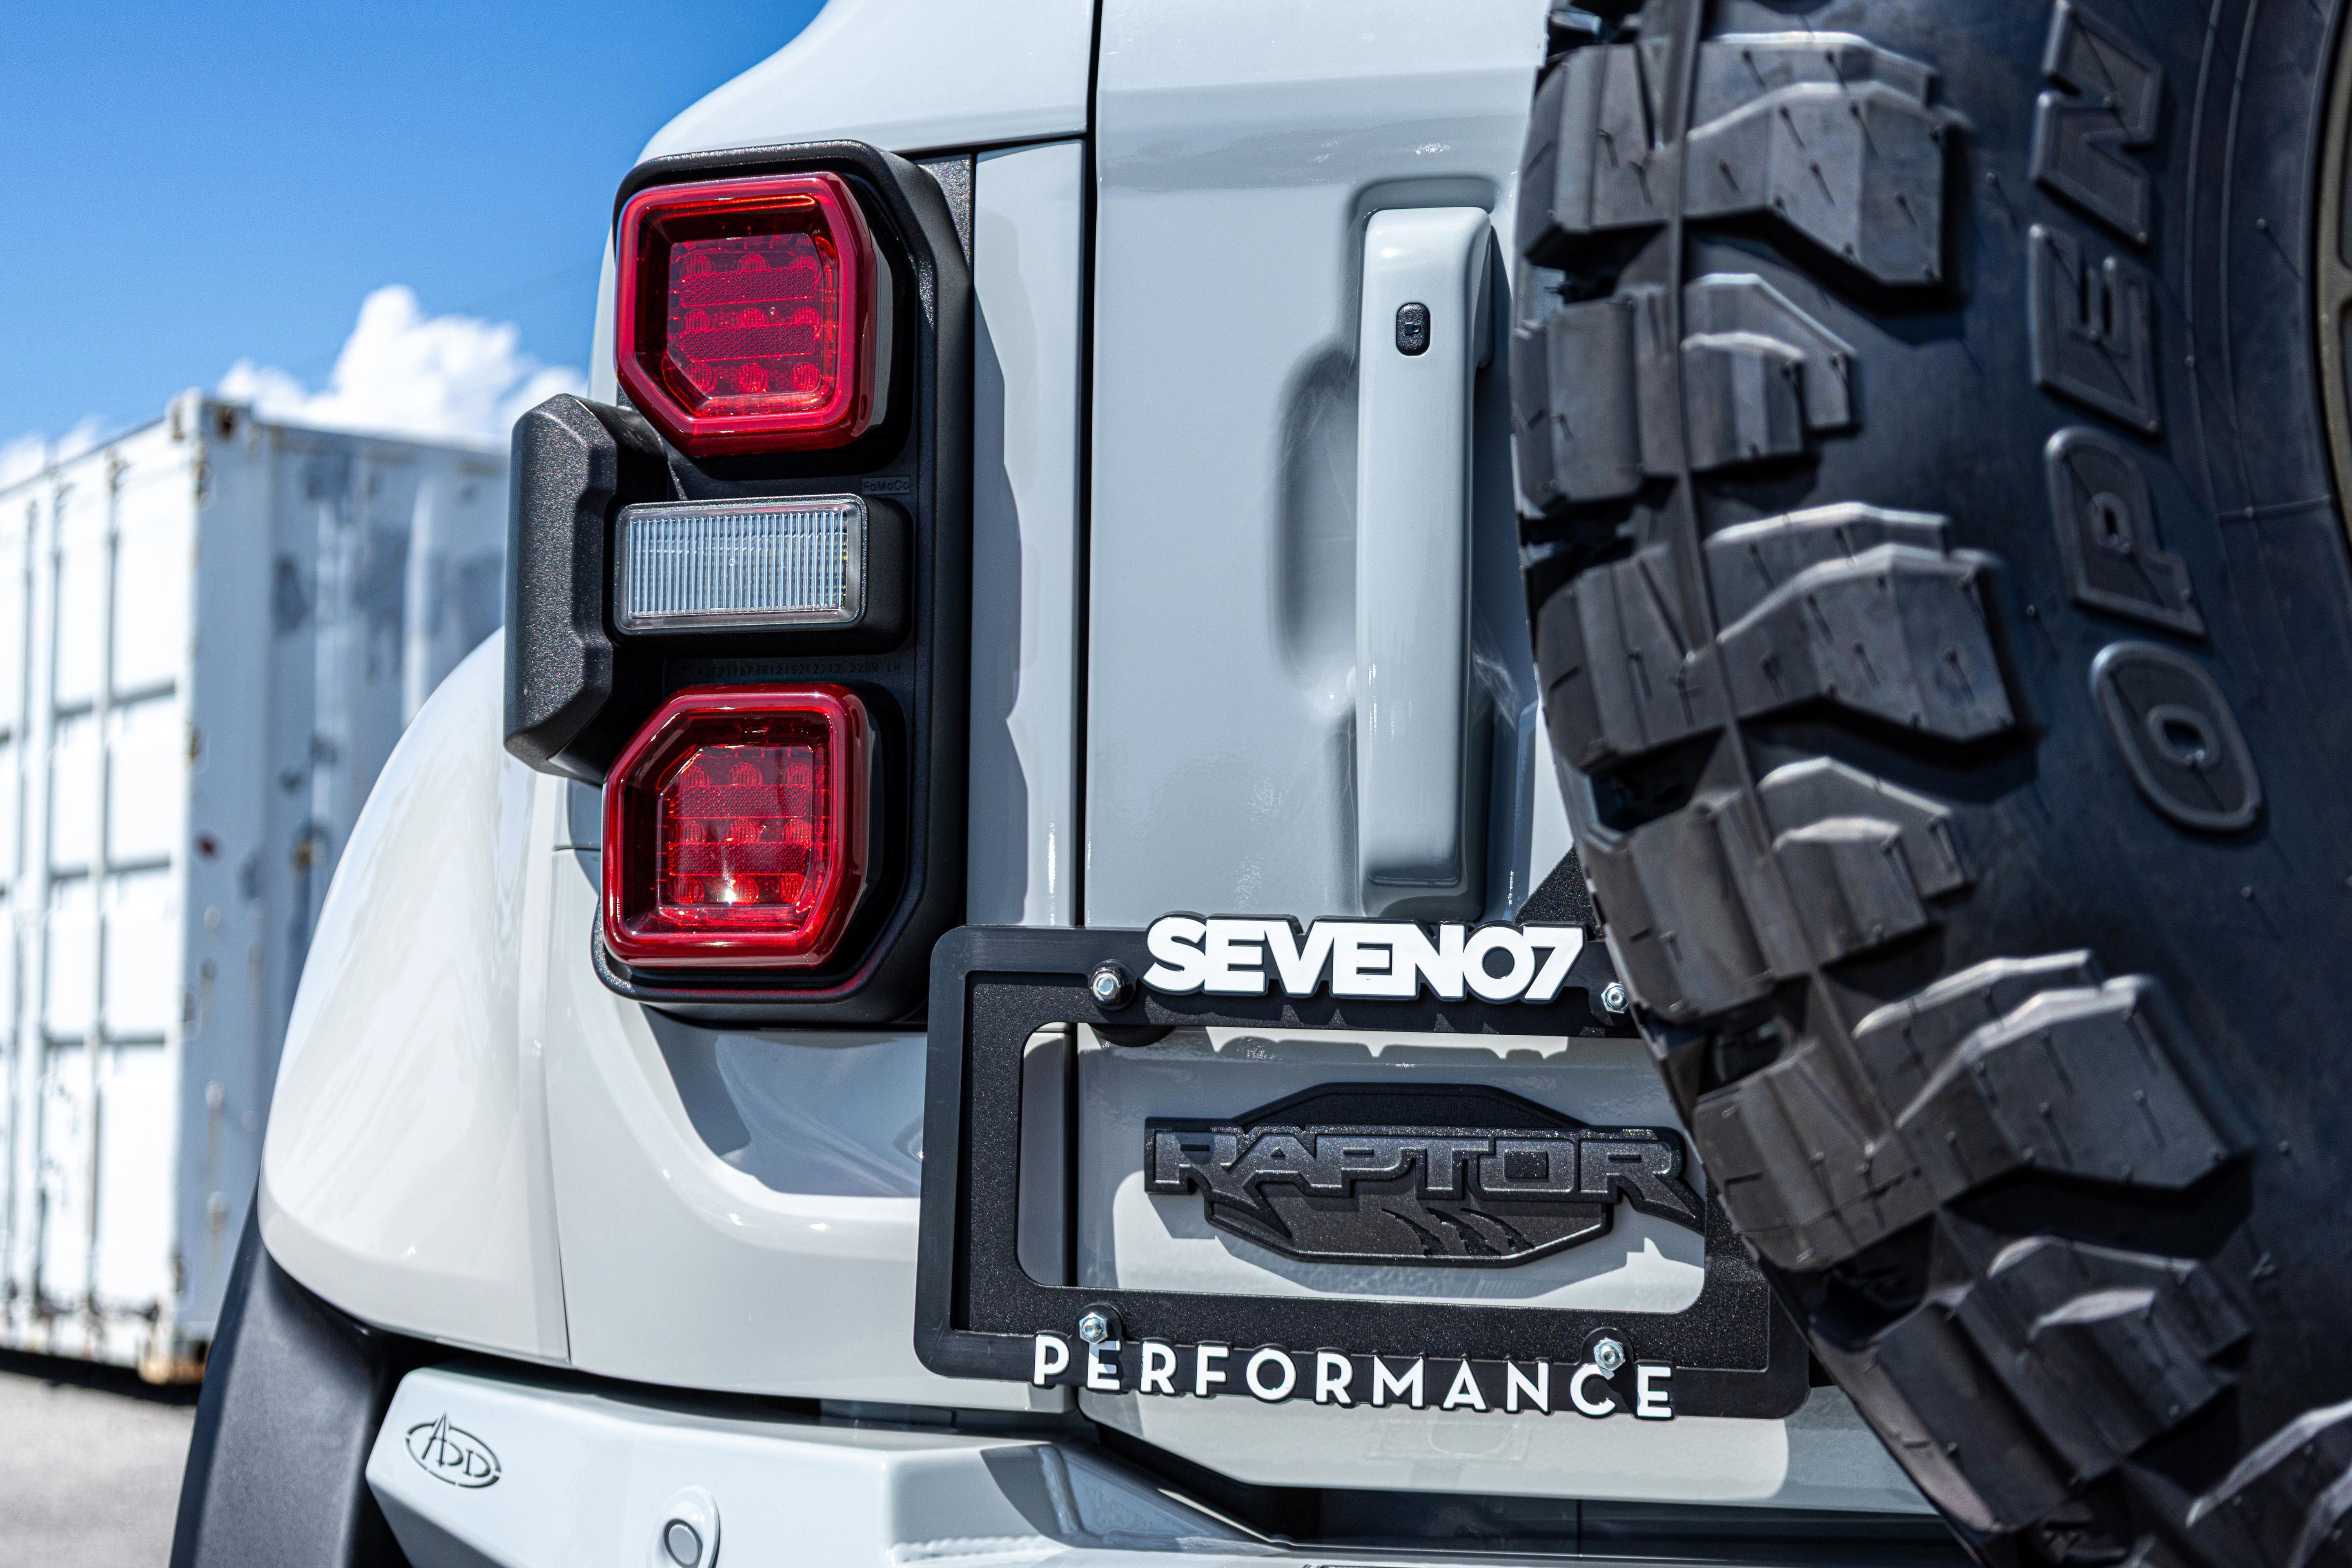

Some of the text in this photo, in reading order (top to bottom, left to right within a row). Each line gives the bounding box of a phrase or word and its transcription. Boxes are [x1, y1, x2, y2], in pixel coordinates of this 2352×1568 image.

[2030, 2, 2264, 831] OPEN
[862, 480, 909, 492] FoMoCo
[887, 662, 901, 672] LH
[1149, 1128, 1699, 1221] RAPTOR
[1033, 1334, 1672, 1417] PERFORMANCE
